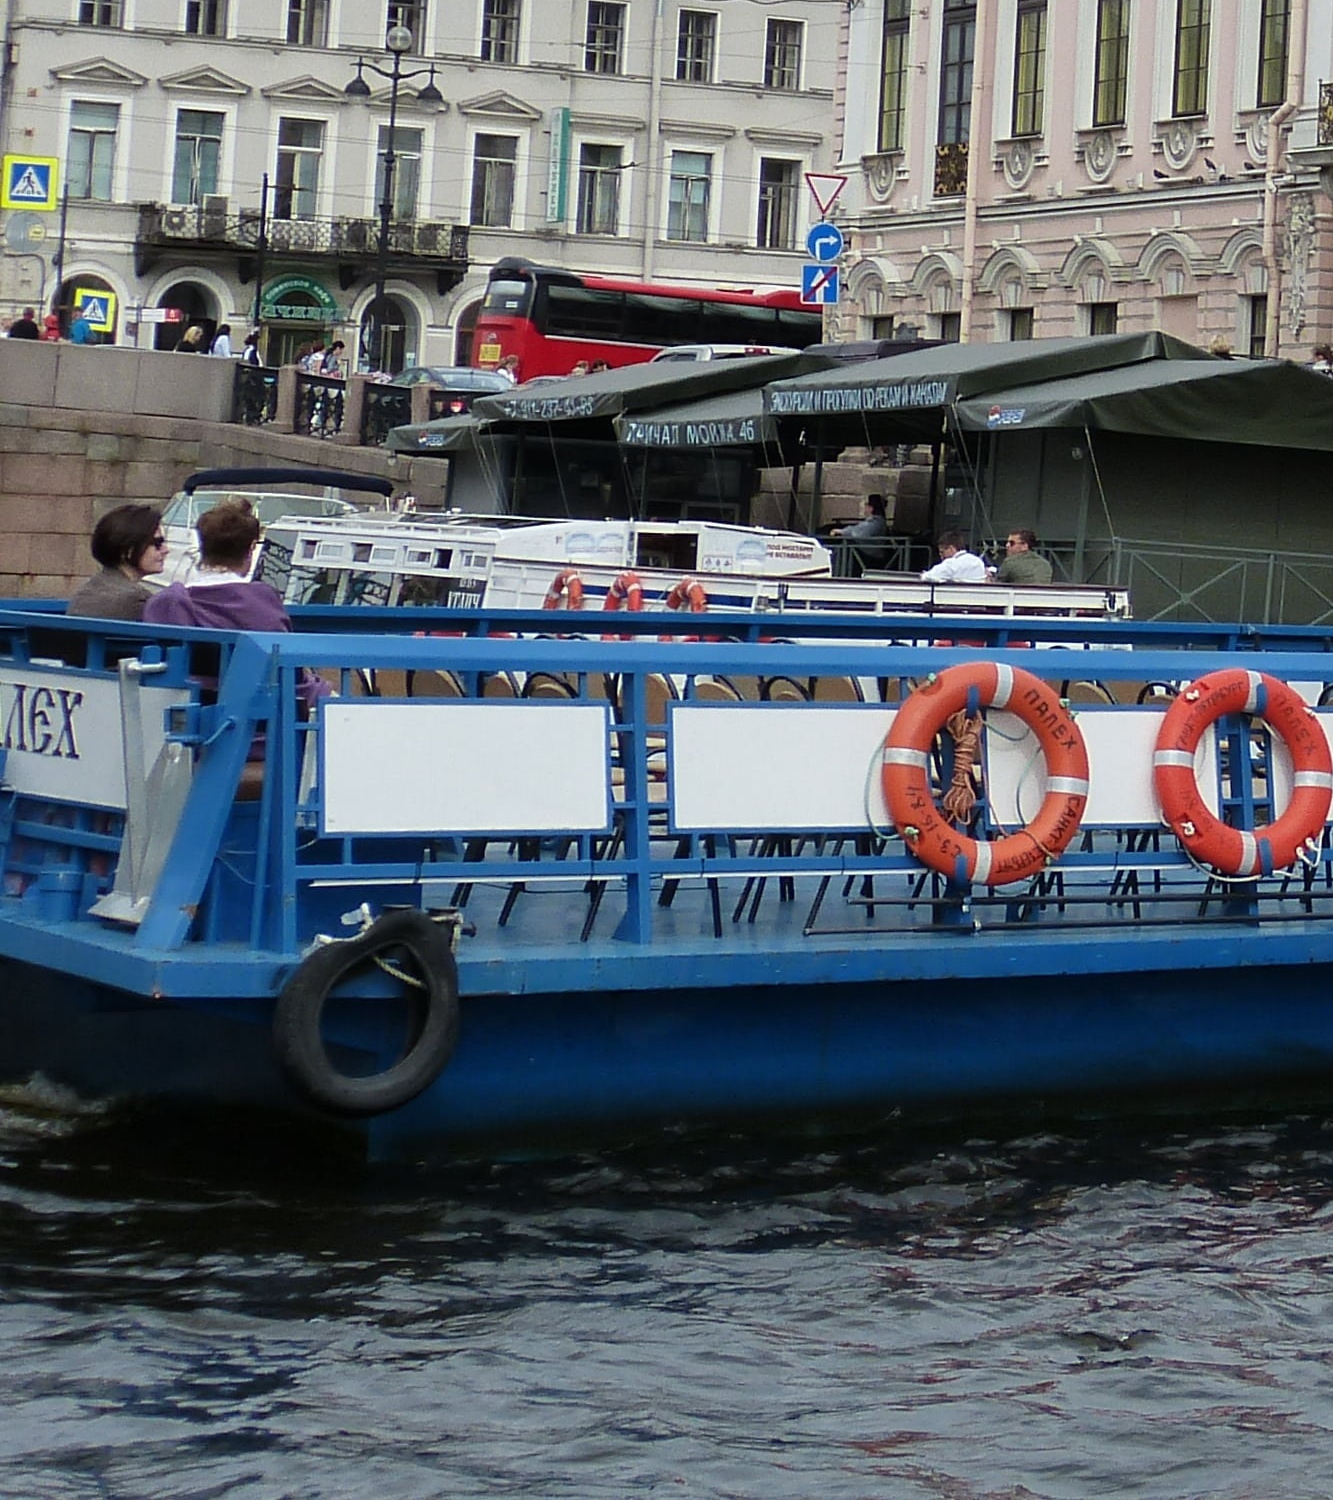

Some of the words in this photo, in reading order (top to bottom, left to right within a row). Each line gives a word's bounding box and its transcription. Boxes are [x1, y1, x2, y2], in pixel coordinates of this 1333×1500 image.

[739, 420, 755, 441] 46
[0, 682, 84, 760] ЛЕХ
[1023, 687, 1077, 750] ПАЛЕХ
